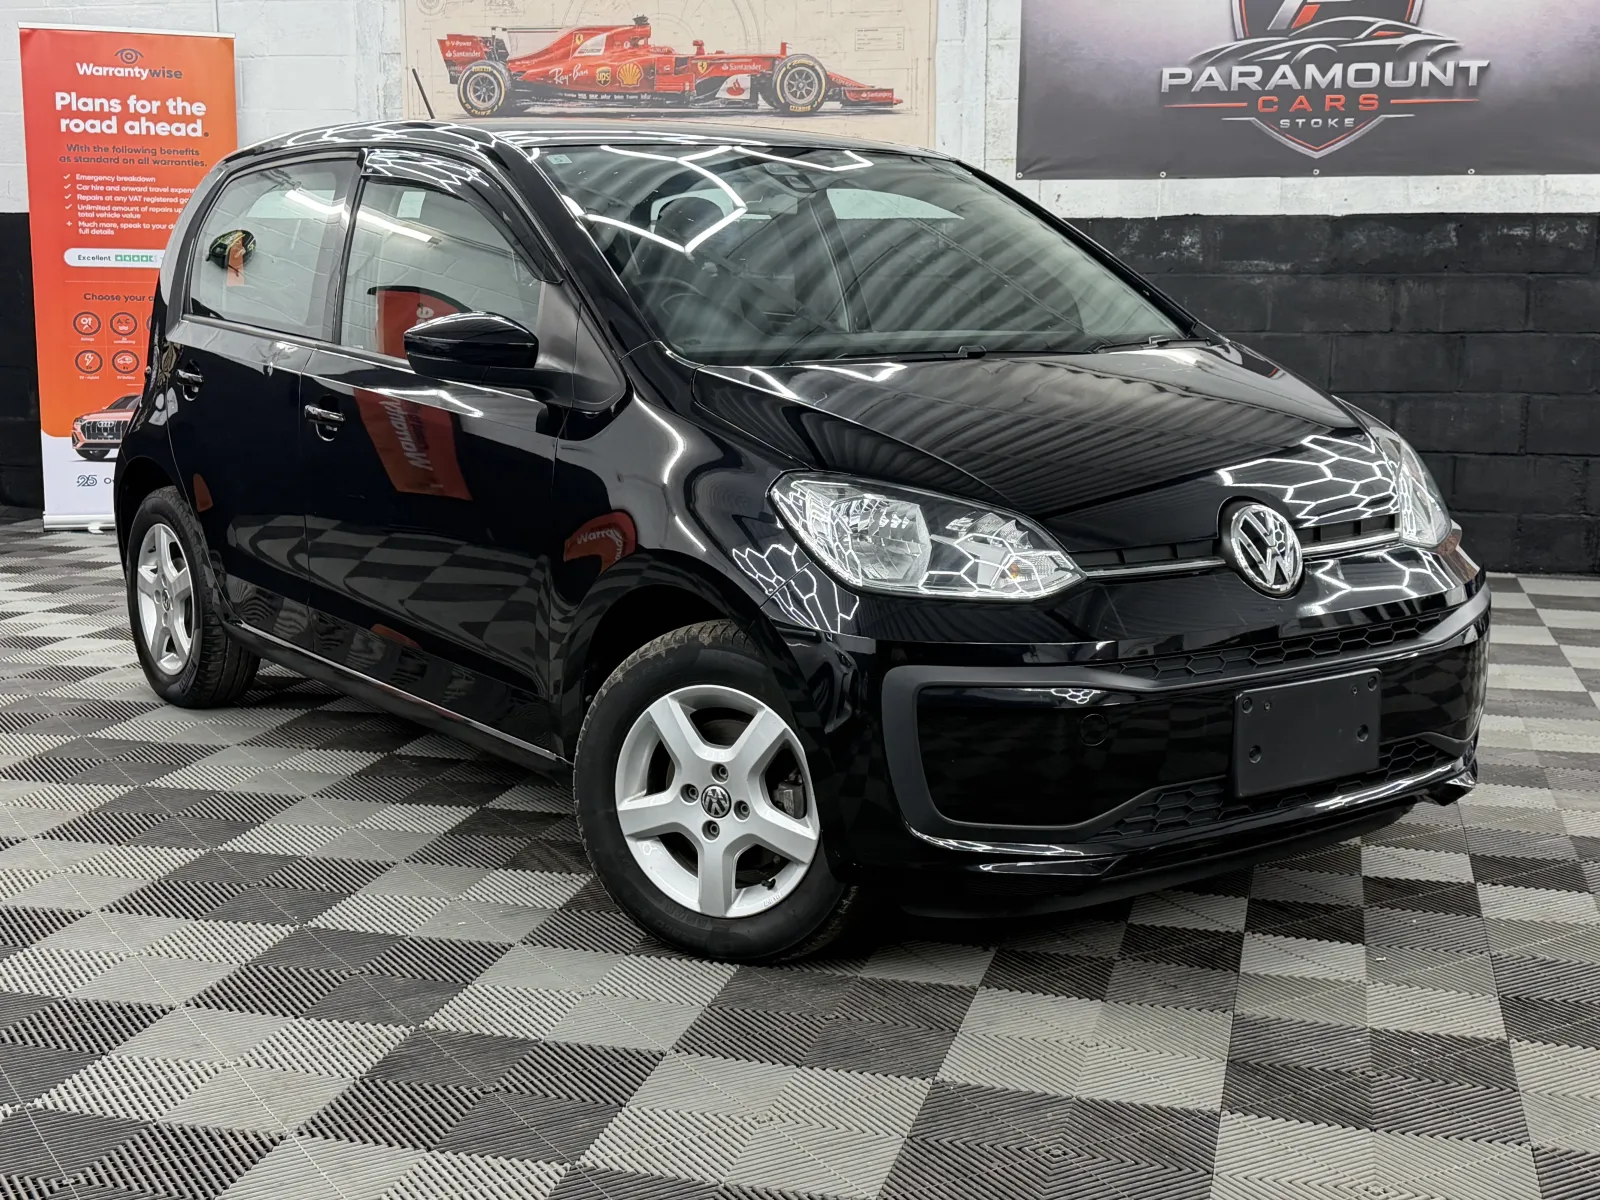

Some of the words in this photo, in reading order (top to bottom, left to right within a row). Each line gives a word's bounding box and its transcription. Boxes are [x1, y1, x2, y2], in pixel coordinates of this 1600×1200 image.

[76, 62, 183, 80] Warrantywise
[729, 63, 762, 71] Santander
[549, 63, 589, 85] Ray-Ban
[1161, 59, 1491, 92] PARAMOUNT
[55, 91, 122, 113] Plans
[127, 94, 161, 113] for
[166, 97, 207, 116] the
[1257, 93, 1380, 113] CARS
[60, 115, 118, 134] road
[124, 116, 209, 137] ahead.
[1279, 117, 1355, 129] STOKE
[66, 144, 90, 152] With
[93, 145, 109, 153] the
[112, 145, 157, 156] following
[160, 147, 200, 156] benefits
[74, 156, 120, 164] standard
[152, 158, 208, 167] warranties.
[75, 173, 115, 182] Emergency
[116, 175, 156, 183] breakdown
[77, 194, 103, 202] Repairs
[143, 196, 178, 204] registered
[149, 206, 173, 214] repairs
[120, 222, 141, 230] speak
[77, 254, 111, 262] Excellent
[83, 292, 121, 301] Choose
[123, 294, 146, 303] your
